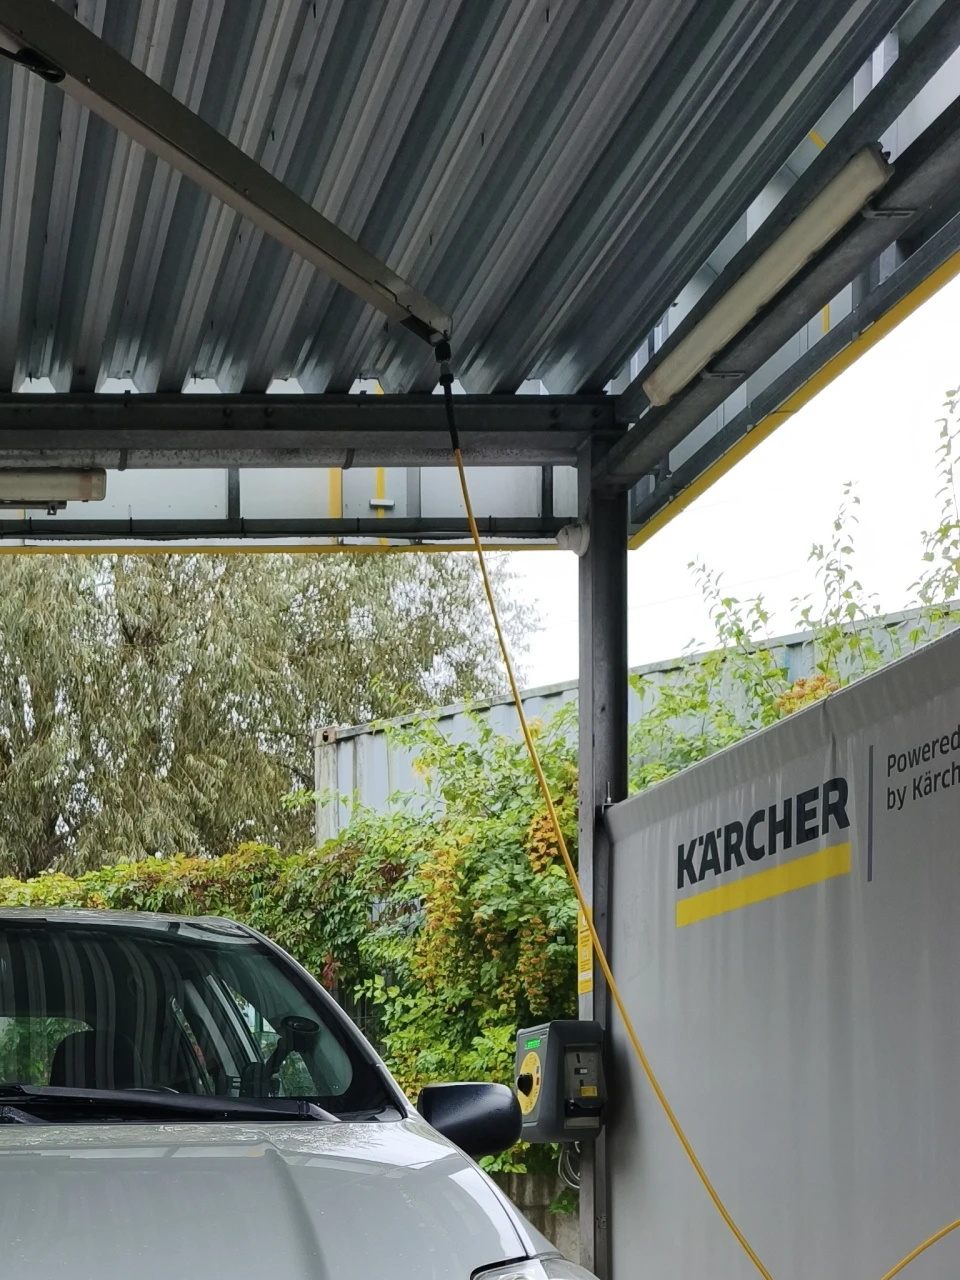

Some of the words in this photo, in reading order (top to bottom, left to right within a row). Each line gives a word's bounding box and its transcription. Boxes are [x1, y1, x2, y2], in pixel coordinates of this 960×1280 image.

[887, 724, 960, 777] Powered
[887, 787, 907, 811] by
[677, 777, 851, 889] KÄRCHER
